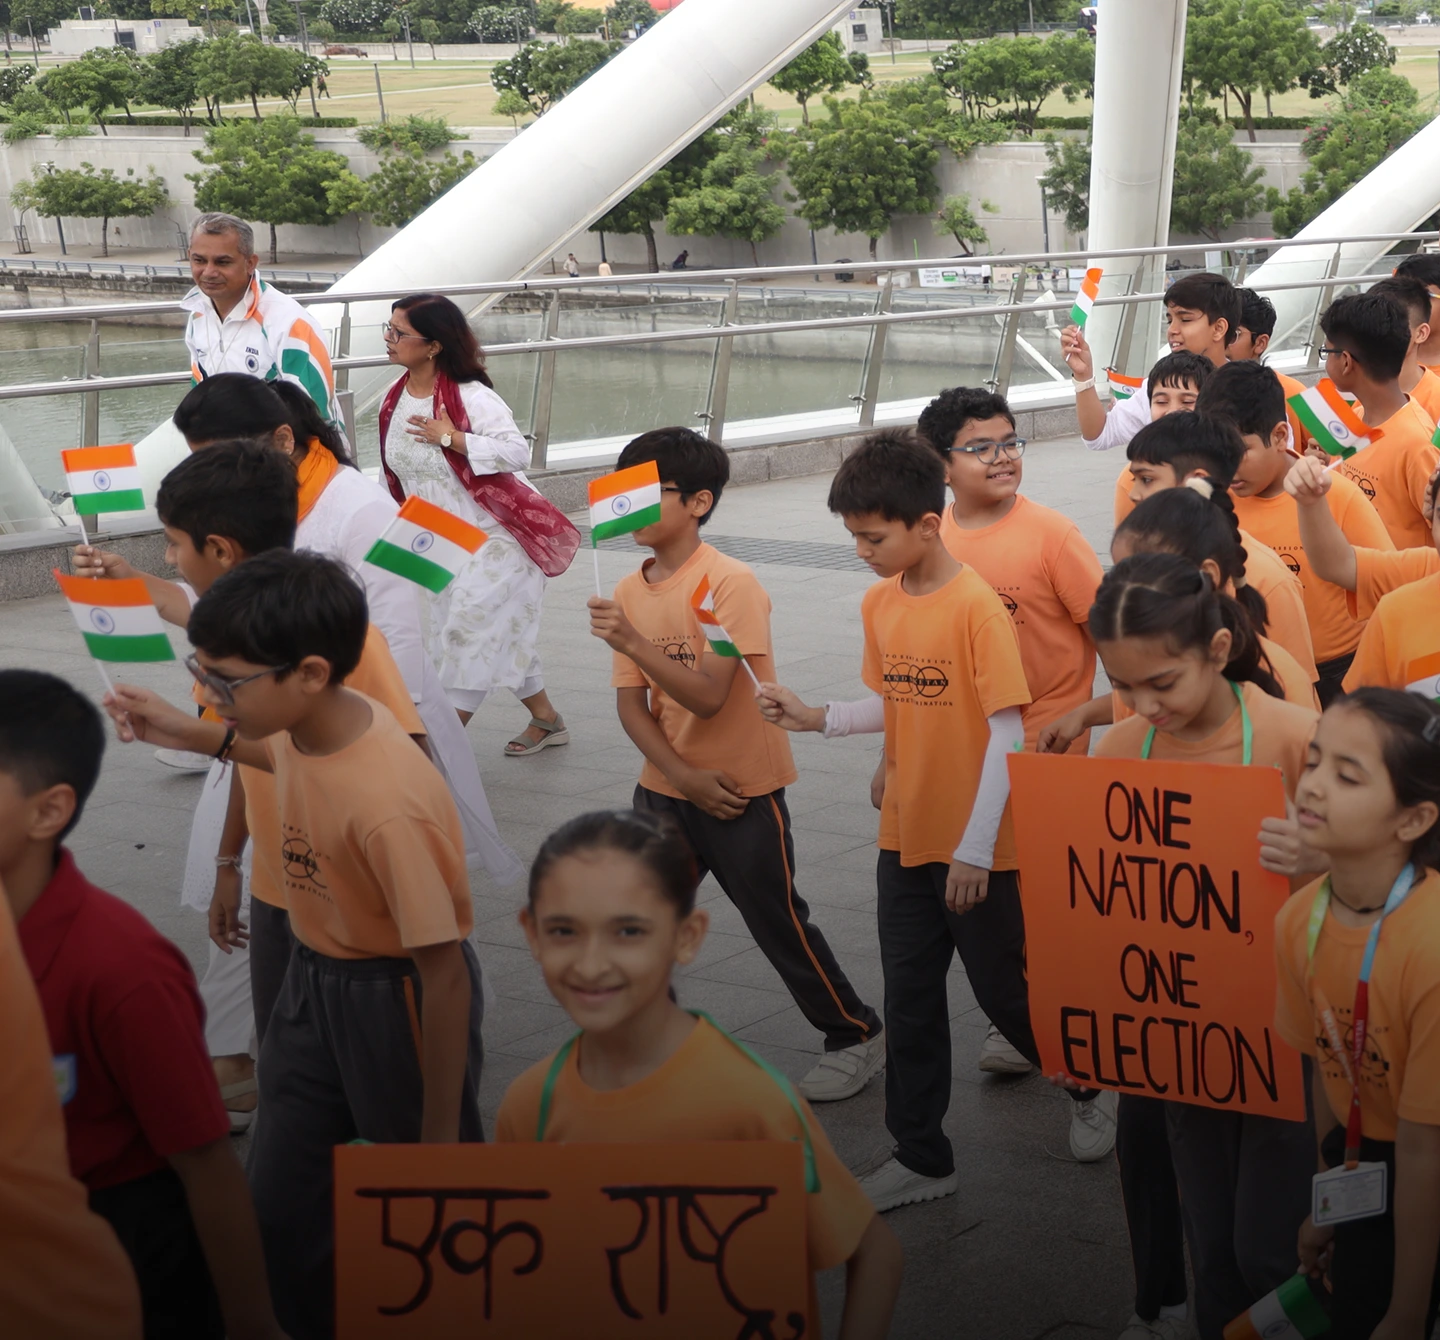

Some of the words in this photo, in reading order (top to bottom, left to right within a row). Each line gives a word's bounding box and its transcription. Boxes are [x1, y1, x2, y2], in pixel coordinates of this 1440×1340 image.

[1105, 781, 1192, 849] ONE
[1067, 844, 1254, 946] NATION,
[1120, 943, 1201, 1009] ONE
[1060, 1006, 1279, 1104] ELECTION
[354, 1187, 552, 1321] एक
